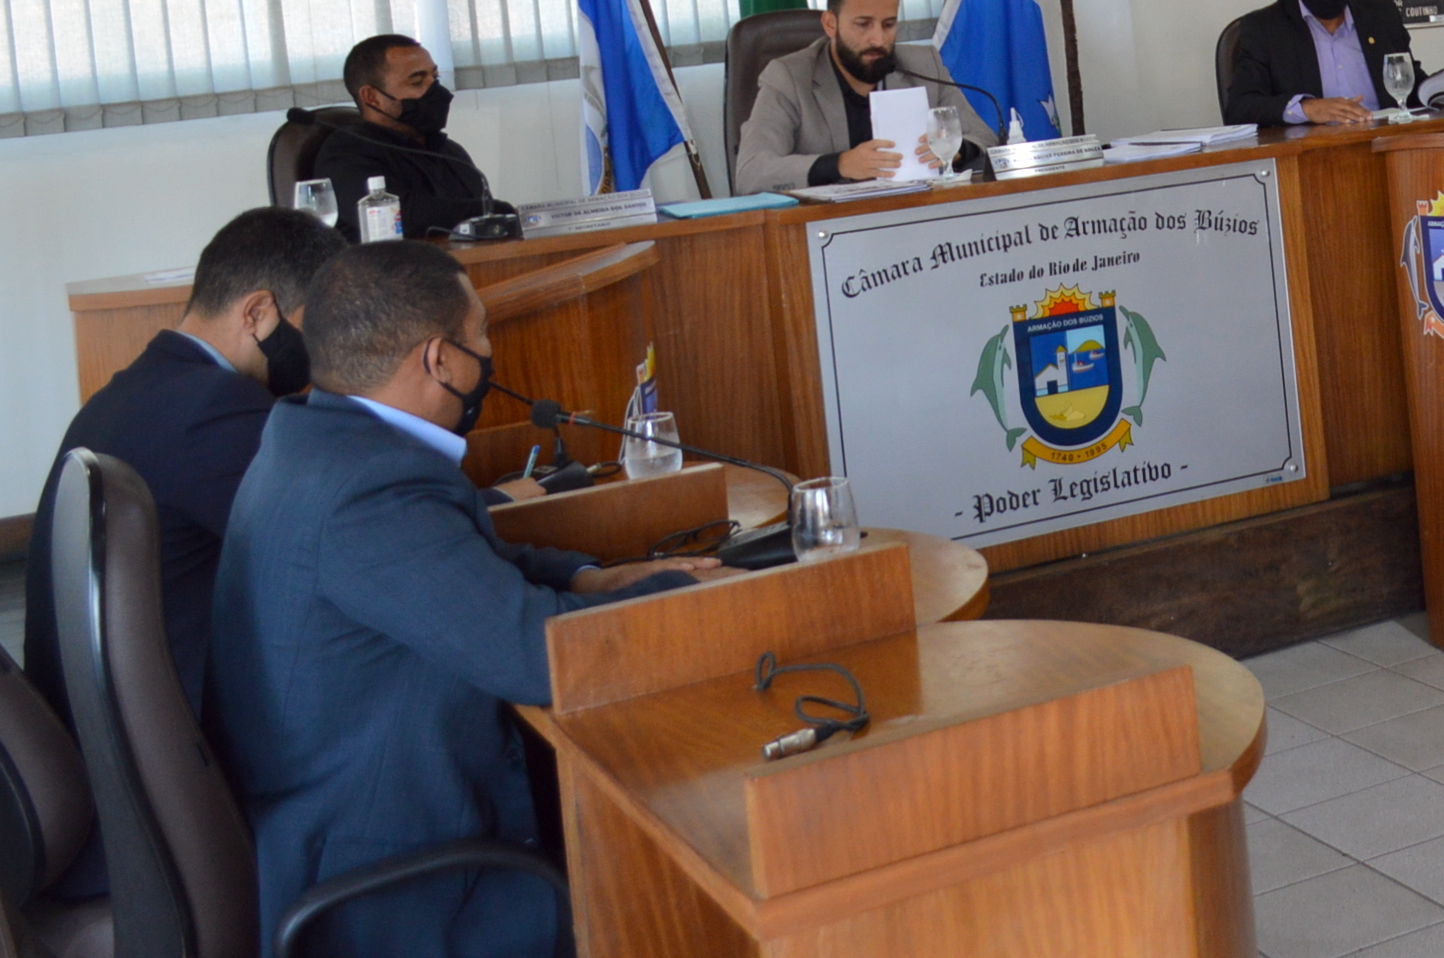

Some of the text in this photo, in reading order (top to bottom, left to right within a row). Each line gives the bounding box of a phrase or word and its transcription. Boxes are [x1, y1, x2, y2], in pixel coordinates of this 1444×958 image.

[1405, 6, 1438, 17] COUTINHO
[840, 209, 1260, 298] Câmara Municipal de Armação dos Búzios
[979, 250, 1140, 287] Estado do Rio de Janeiro
[1027, 313, 1104, 333] ARMAÇÃO DOS BÚZIOS
[1049, 442, 1108, 463] 1740 1995
[973, 487, 1041, 523] Poder
[1048, 462, 1172, 503] Legislativo
